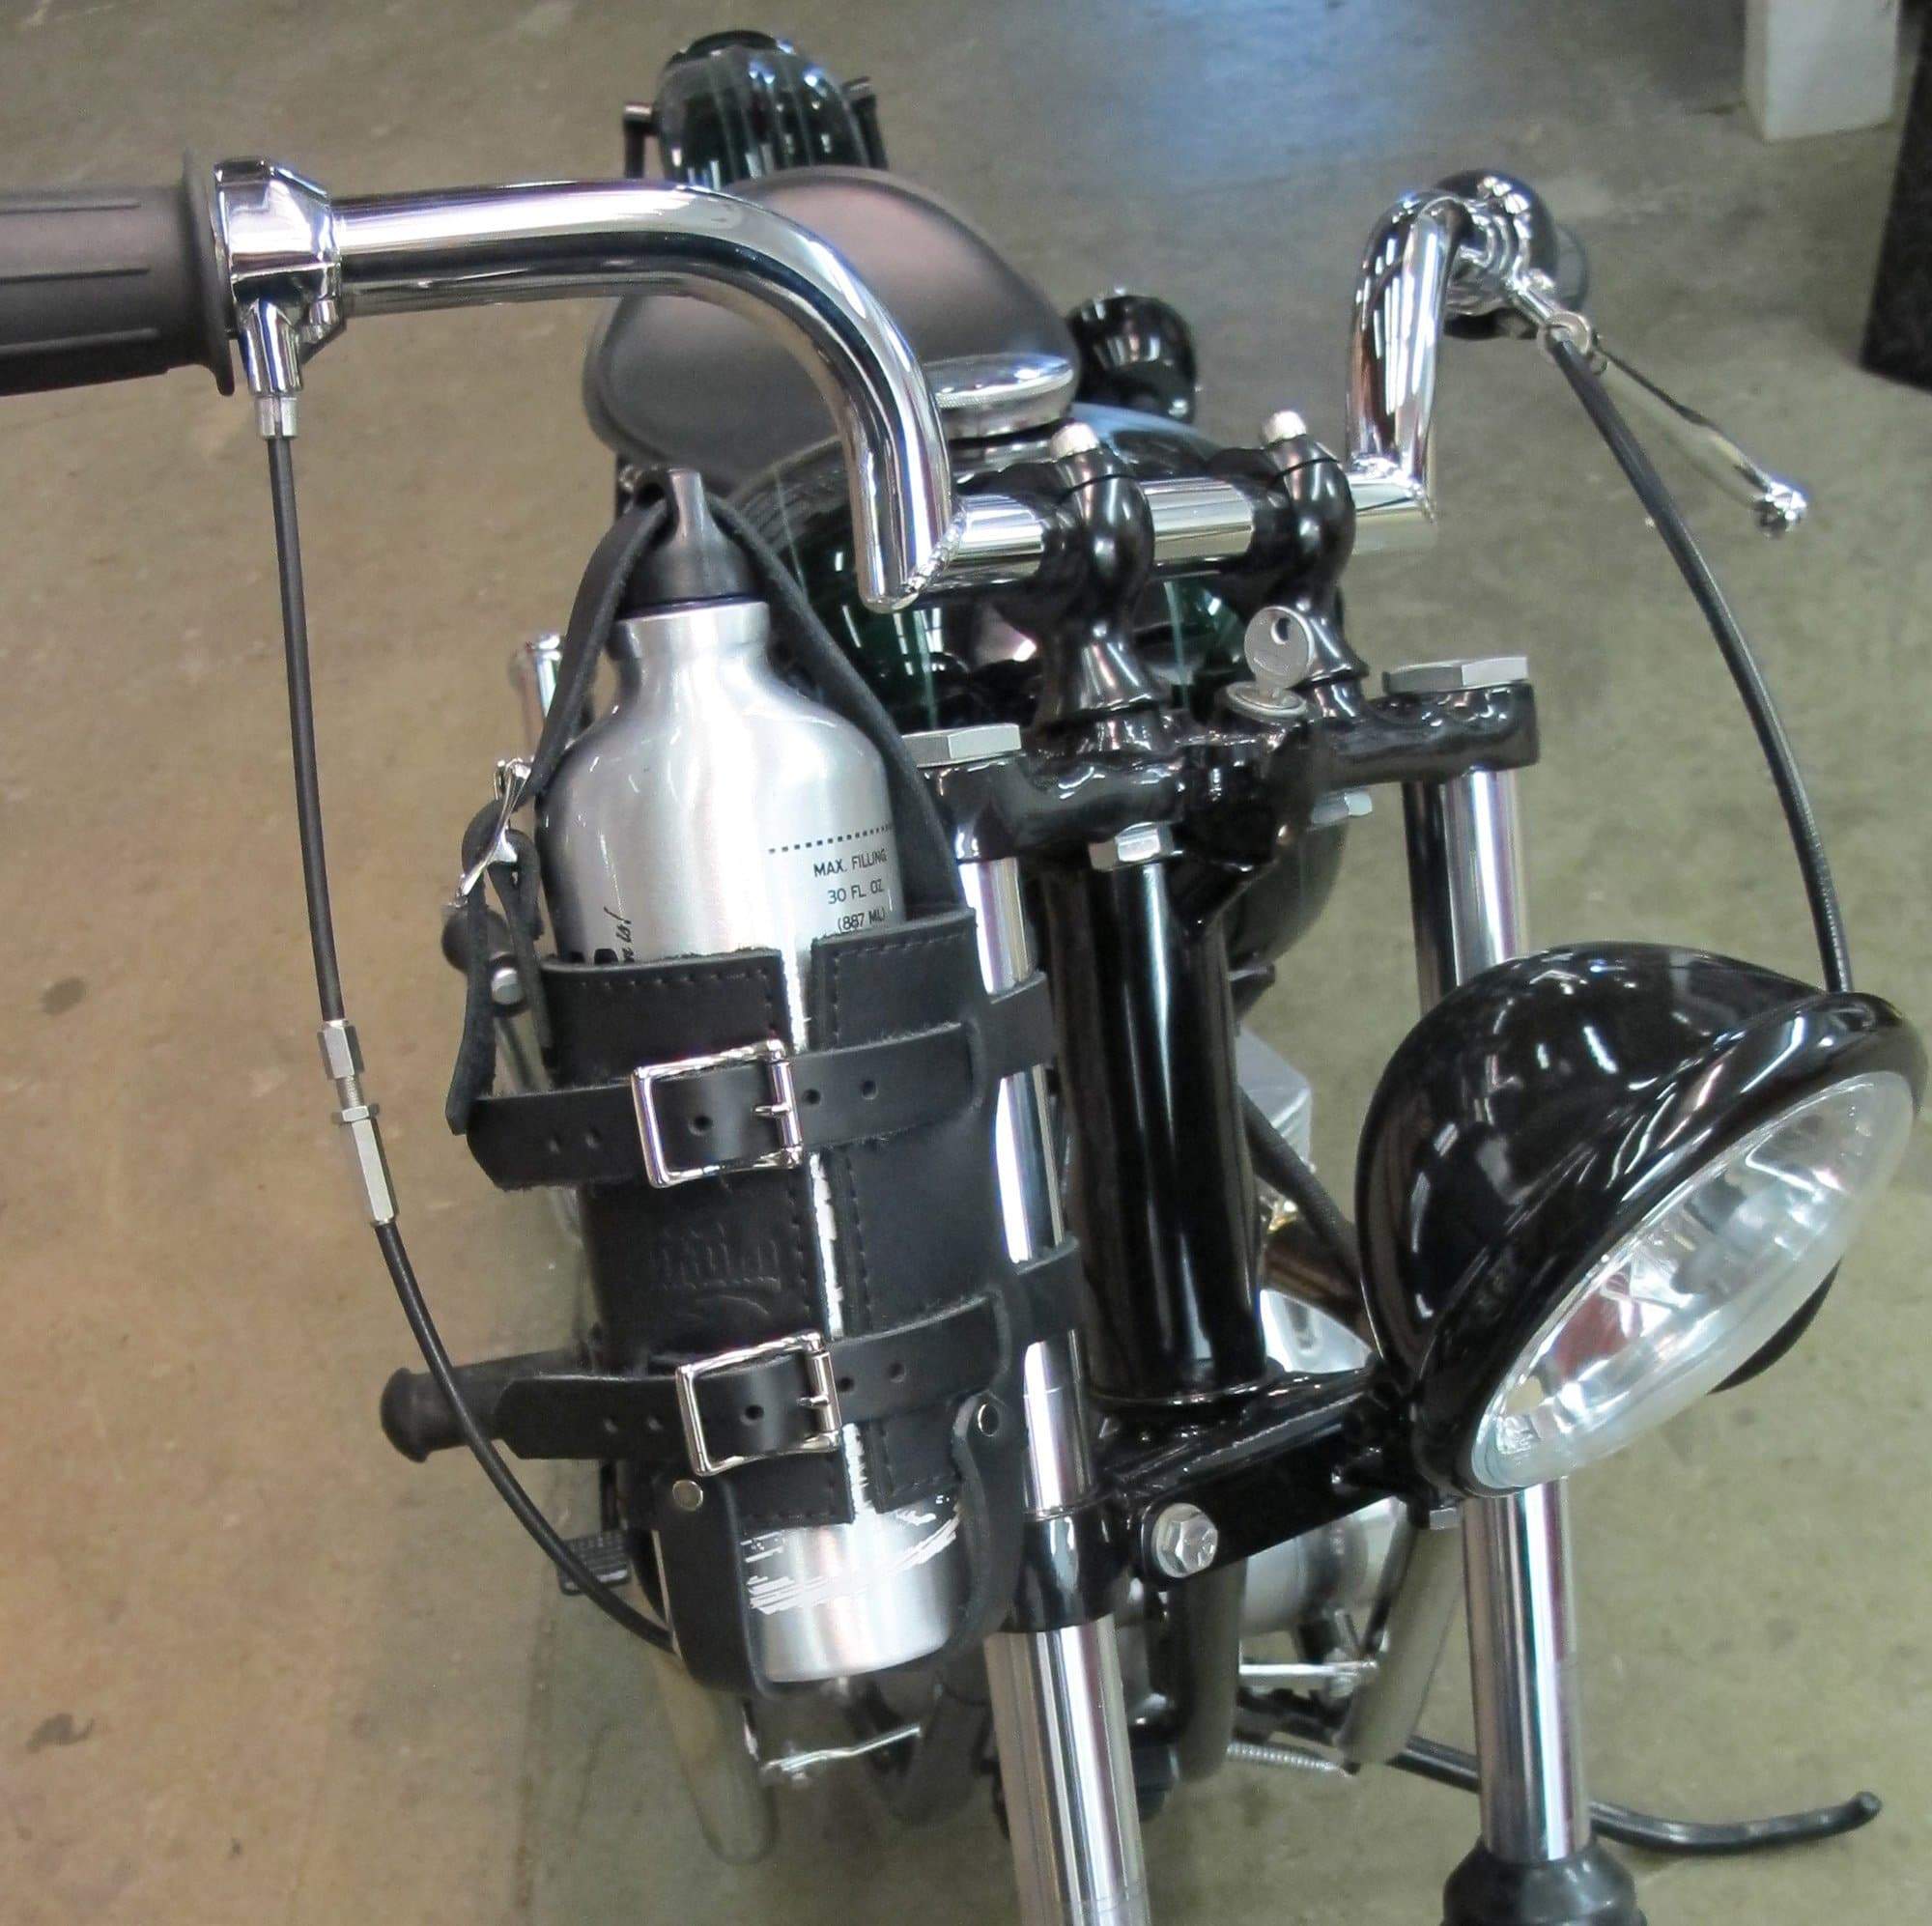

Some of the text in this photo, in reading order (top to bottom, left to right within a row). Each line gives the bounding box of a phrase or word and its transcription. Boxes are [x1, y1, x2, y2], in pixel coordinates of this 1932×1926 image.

[813, 848, 888, 877] MAX. FILLING
[828, 888, 847, 904] 30
[851, 884, 867, 899] FL
[838, 912, 866, 933] (887
